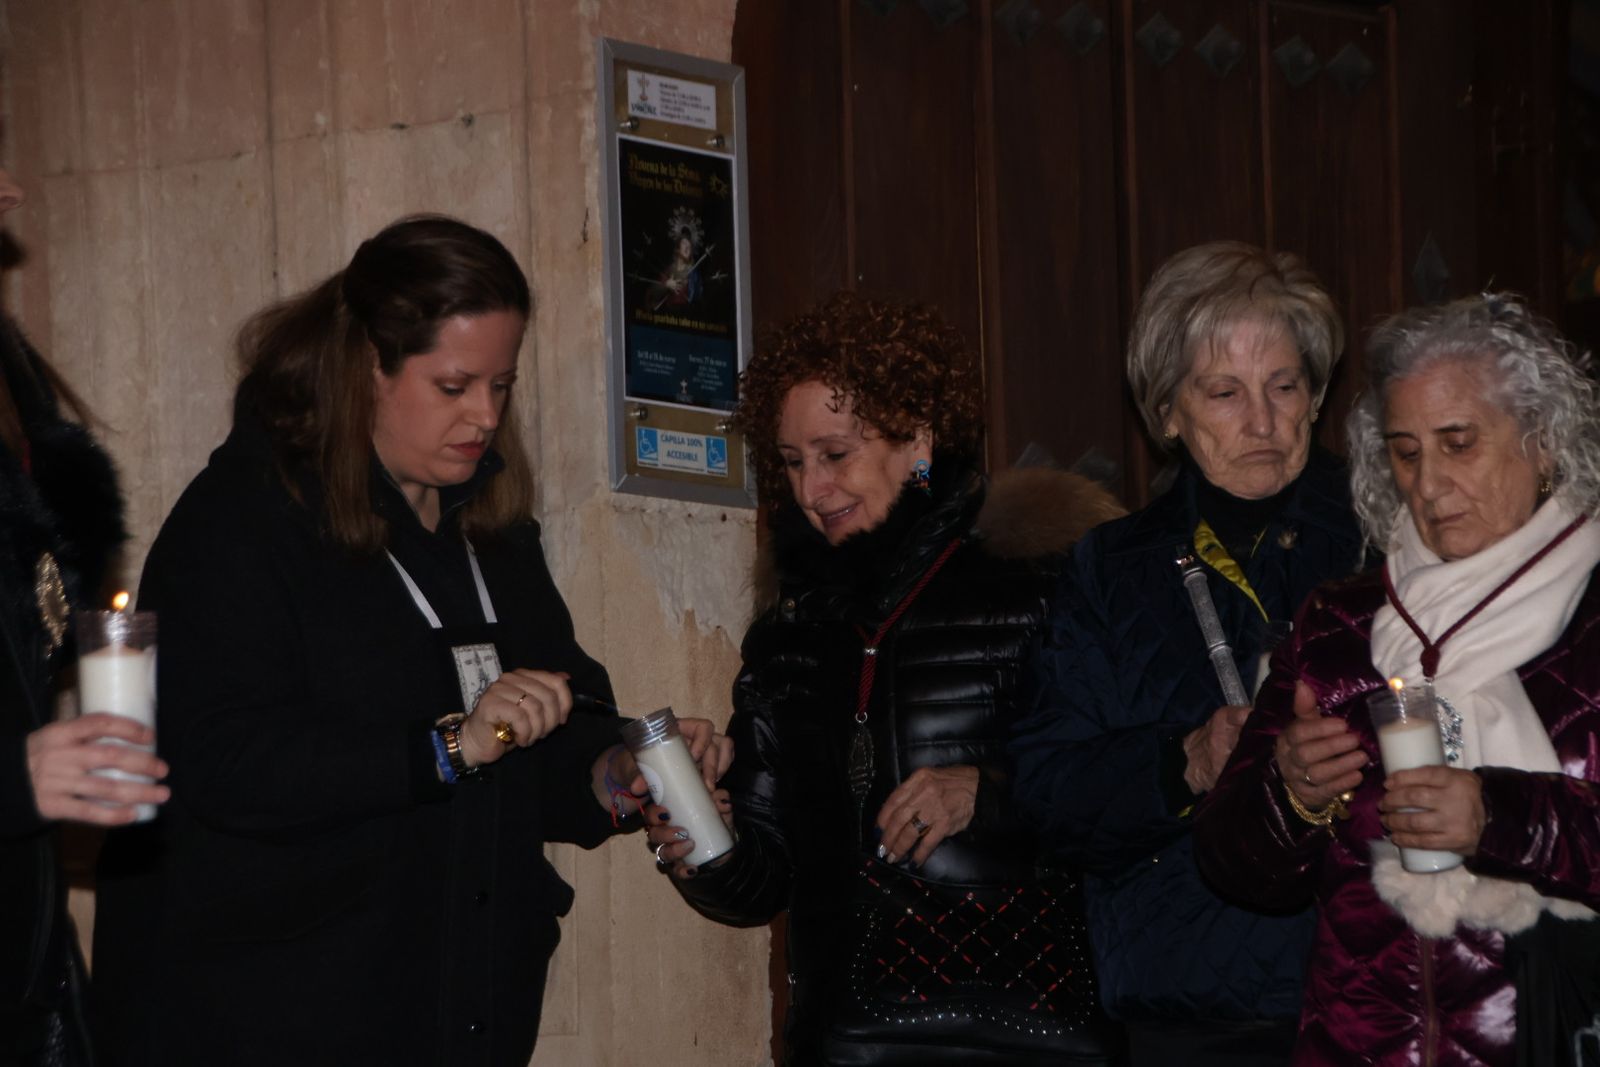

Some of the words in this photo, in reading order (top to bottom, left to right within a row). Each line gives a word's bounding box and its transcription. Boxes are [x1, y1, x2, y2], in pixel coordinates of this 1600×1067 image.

[660, 434, 685, 445] CAPILLA
[687, 437, 703, 447] 100%
[666, 450, 698, 462] ACCESIBLE
